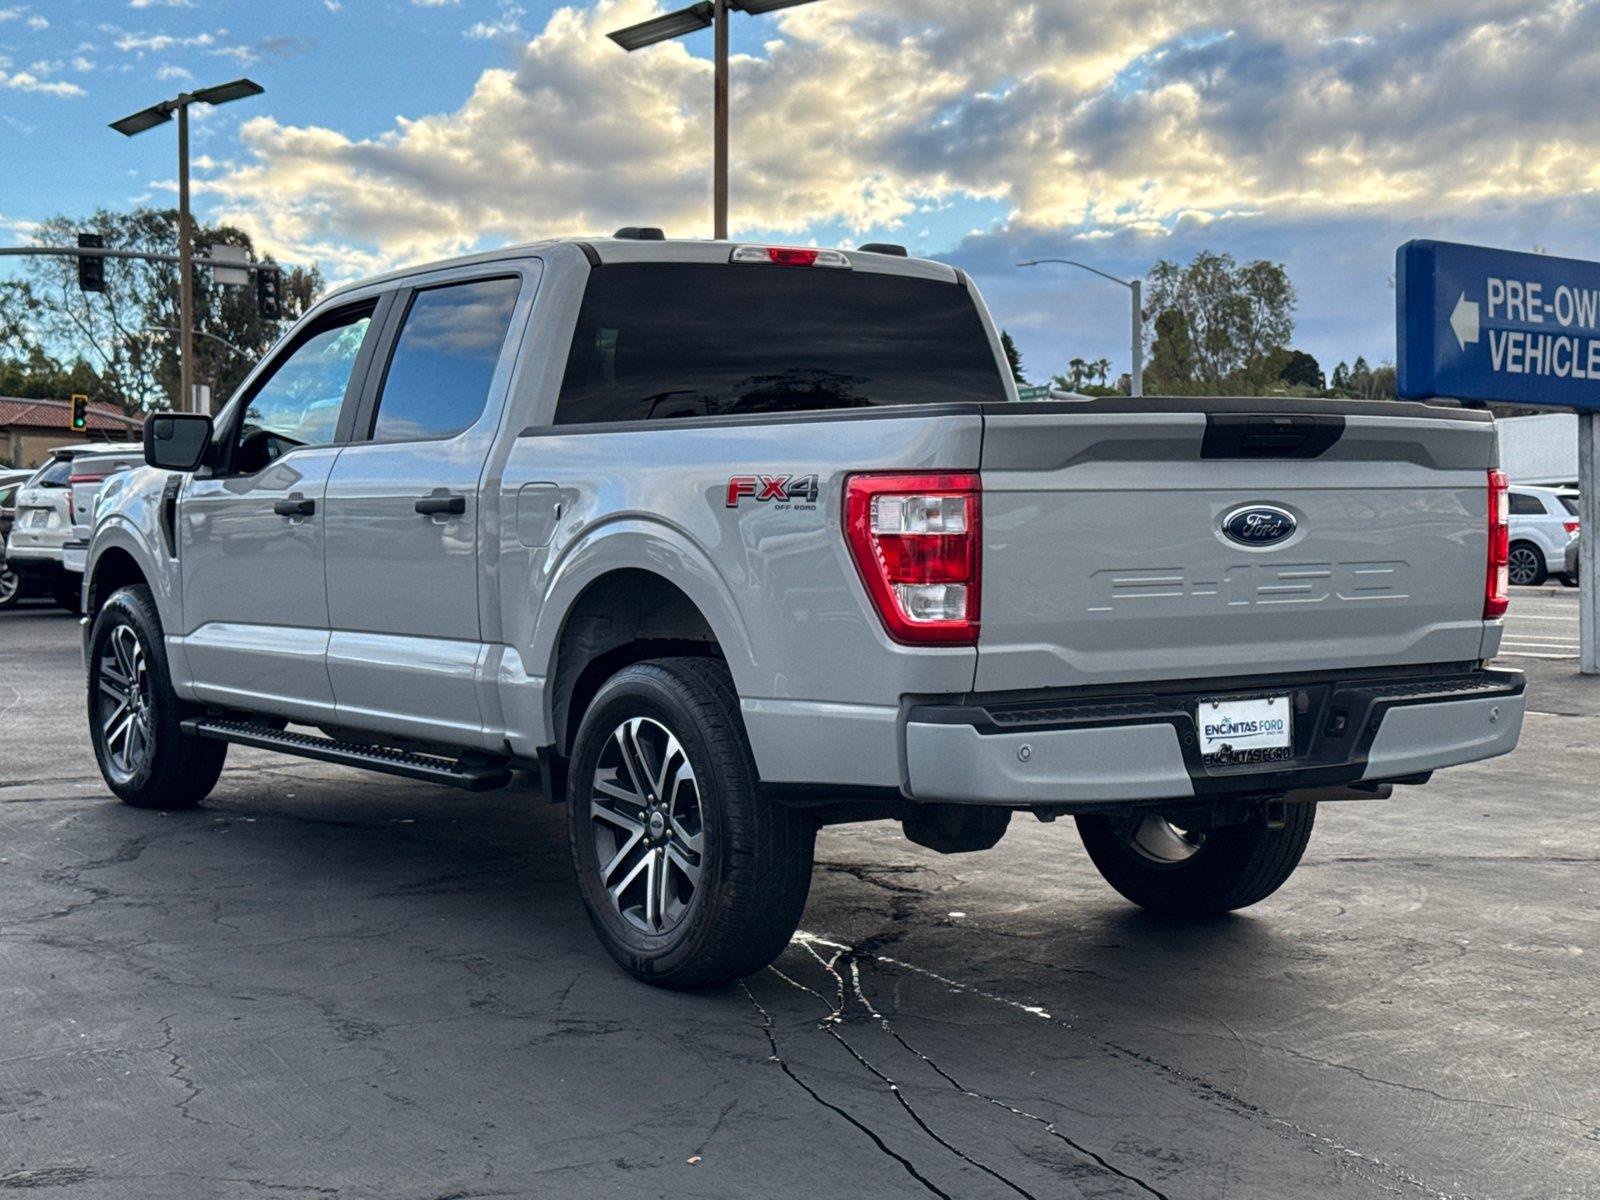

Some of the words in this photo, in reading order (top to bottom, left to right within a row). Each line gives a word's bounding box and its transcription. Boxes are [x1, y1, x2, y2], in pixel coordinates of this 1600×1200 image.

[1487, 277, 1600, 329] PRE-OW
[1488, 329, 1600, 380] VEHICLE
[726, 474, 819, 508] FX4
[1243, 513, 1282, 537] Ford
[1087, 559, 1412, 612] F-150
[1205, 721, 1258, 735] ENCINITAS
[1259, 719, 1283, 731] FORD
